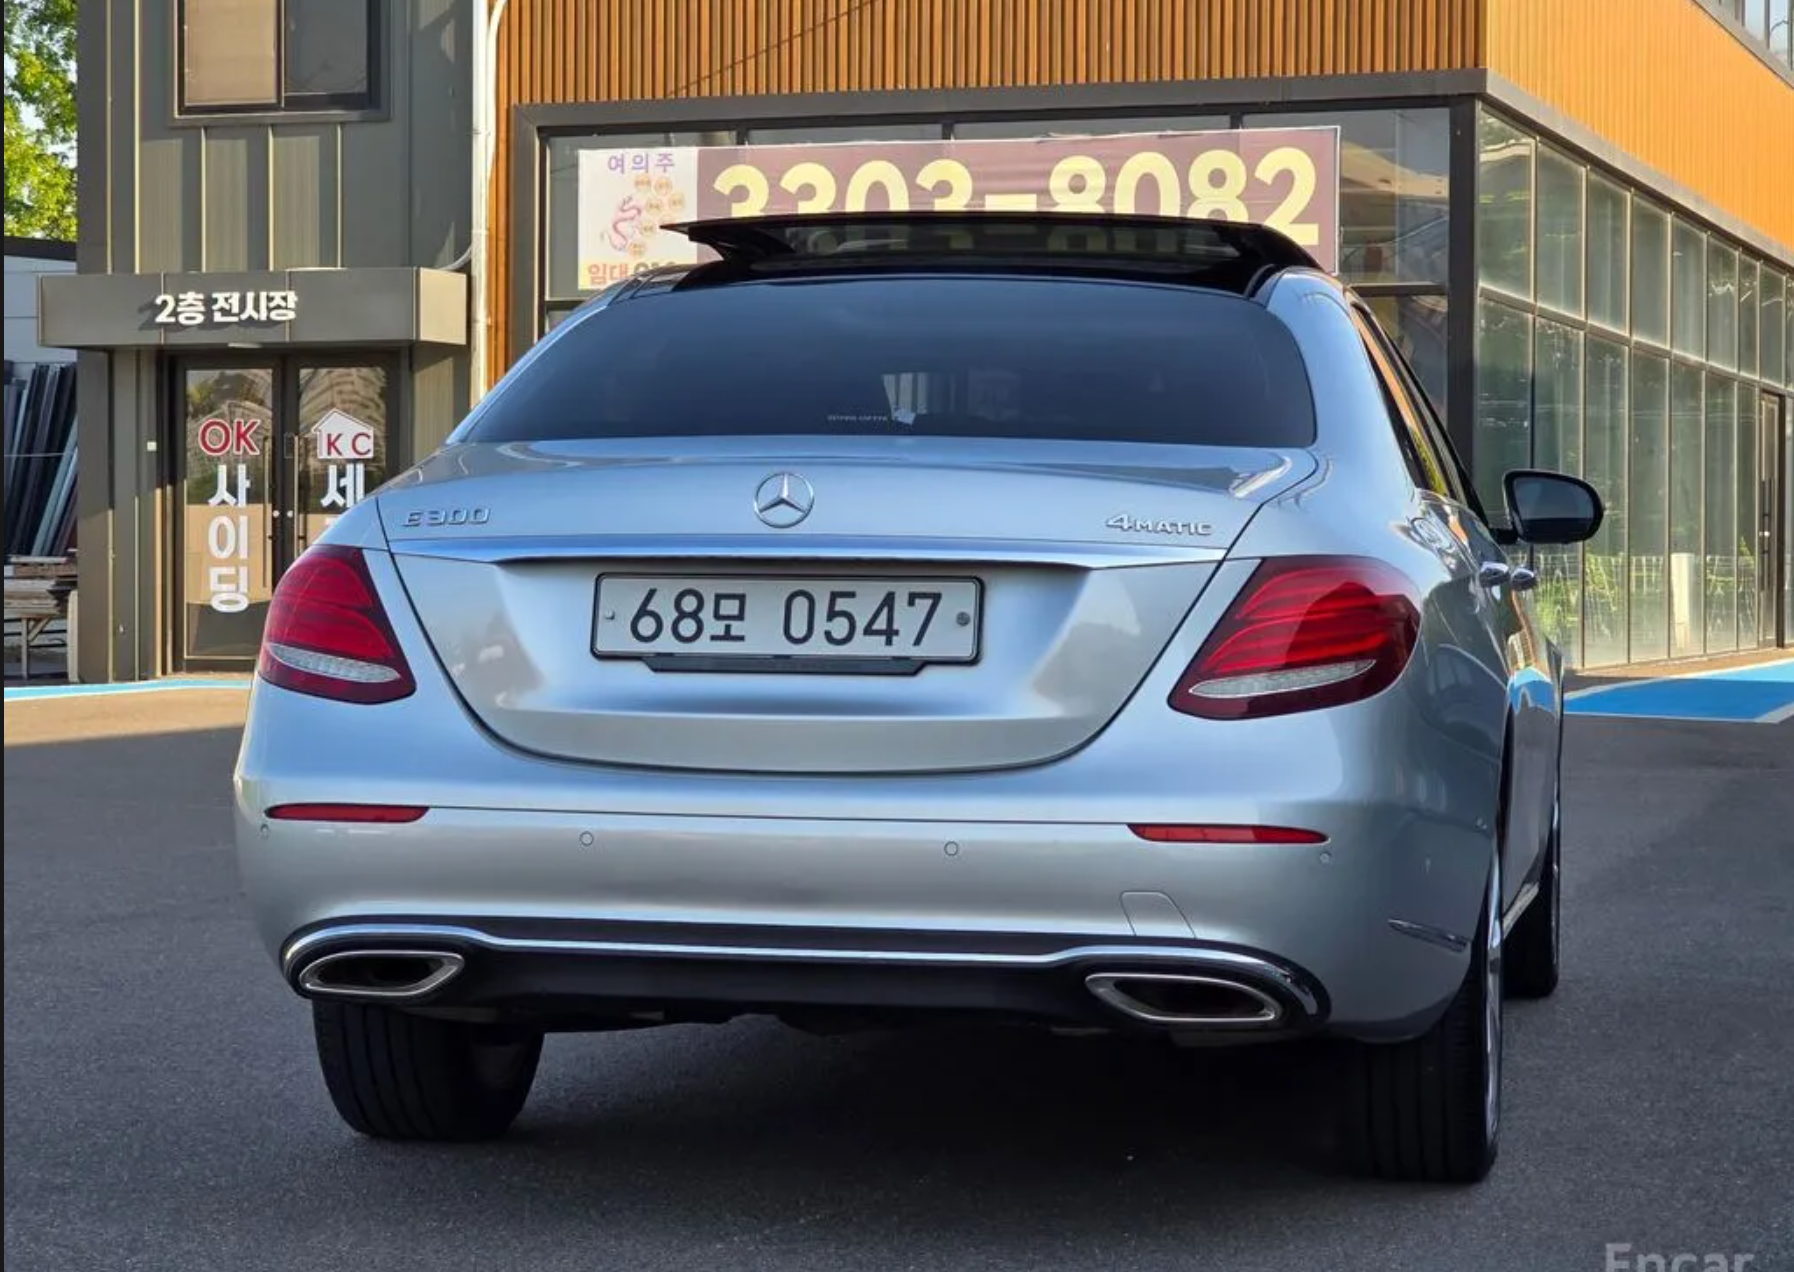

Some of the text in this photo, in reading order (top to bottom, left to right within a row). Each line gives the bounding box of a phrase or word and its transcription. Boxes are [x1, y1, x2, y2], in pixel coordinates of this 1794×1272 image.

[608, 153, 674, 174] 여의주
[155, 290, 299, 326] 2층 전시장
[199, 418, 261, 457] OK
[326, 431, 373, 457] KC
[320, 463, 365, 526] 세
[207, 463, 250, 613] 사이딩
[1105, 513, 1213, 536] 4MATIC
[630, 588, 943, 646] 68모 0547
